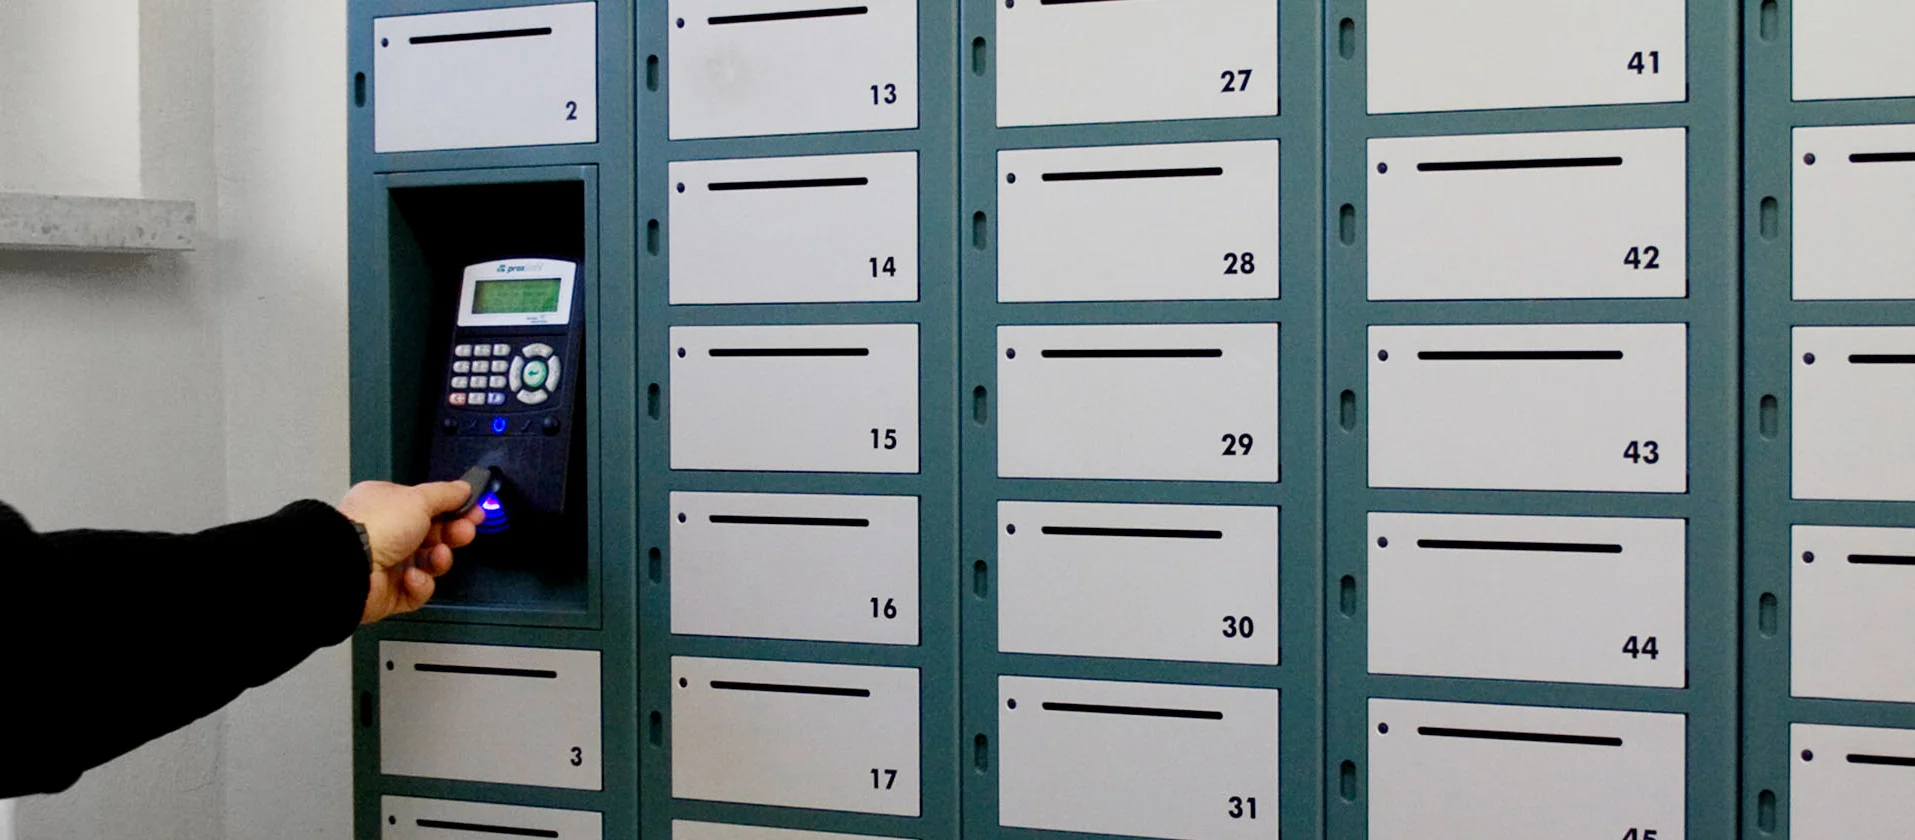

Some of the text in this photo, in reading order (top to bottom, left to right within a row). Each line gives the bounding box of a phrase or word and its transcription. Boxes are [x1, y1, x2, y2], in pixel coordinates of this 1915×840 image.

[1627, 51, 1658, 74] 41
[1220, 69, 1252, 92] 27
[870, 84, 896, 105] 13
[565, 101, 576, 120] 2
[869, 257, 896, 277] 14
[1223, 252, 1254, 274] 28
[1623, 246, 1659, 269] 42
[870, 428, 896, 449] 15
[1221, 433, 1253, 455] 29
[1622, 441, 1659, 464] 43
[869, 597, 897, 619] 16
[1222, 616, 1254, 638] 30
[1621, 636, 1658, 659] 44
[569, 746, 582, 767] 3
[870, 768, 897, 790] 17
[1228, 796, 1256, 819] 31
